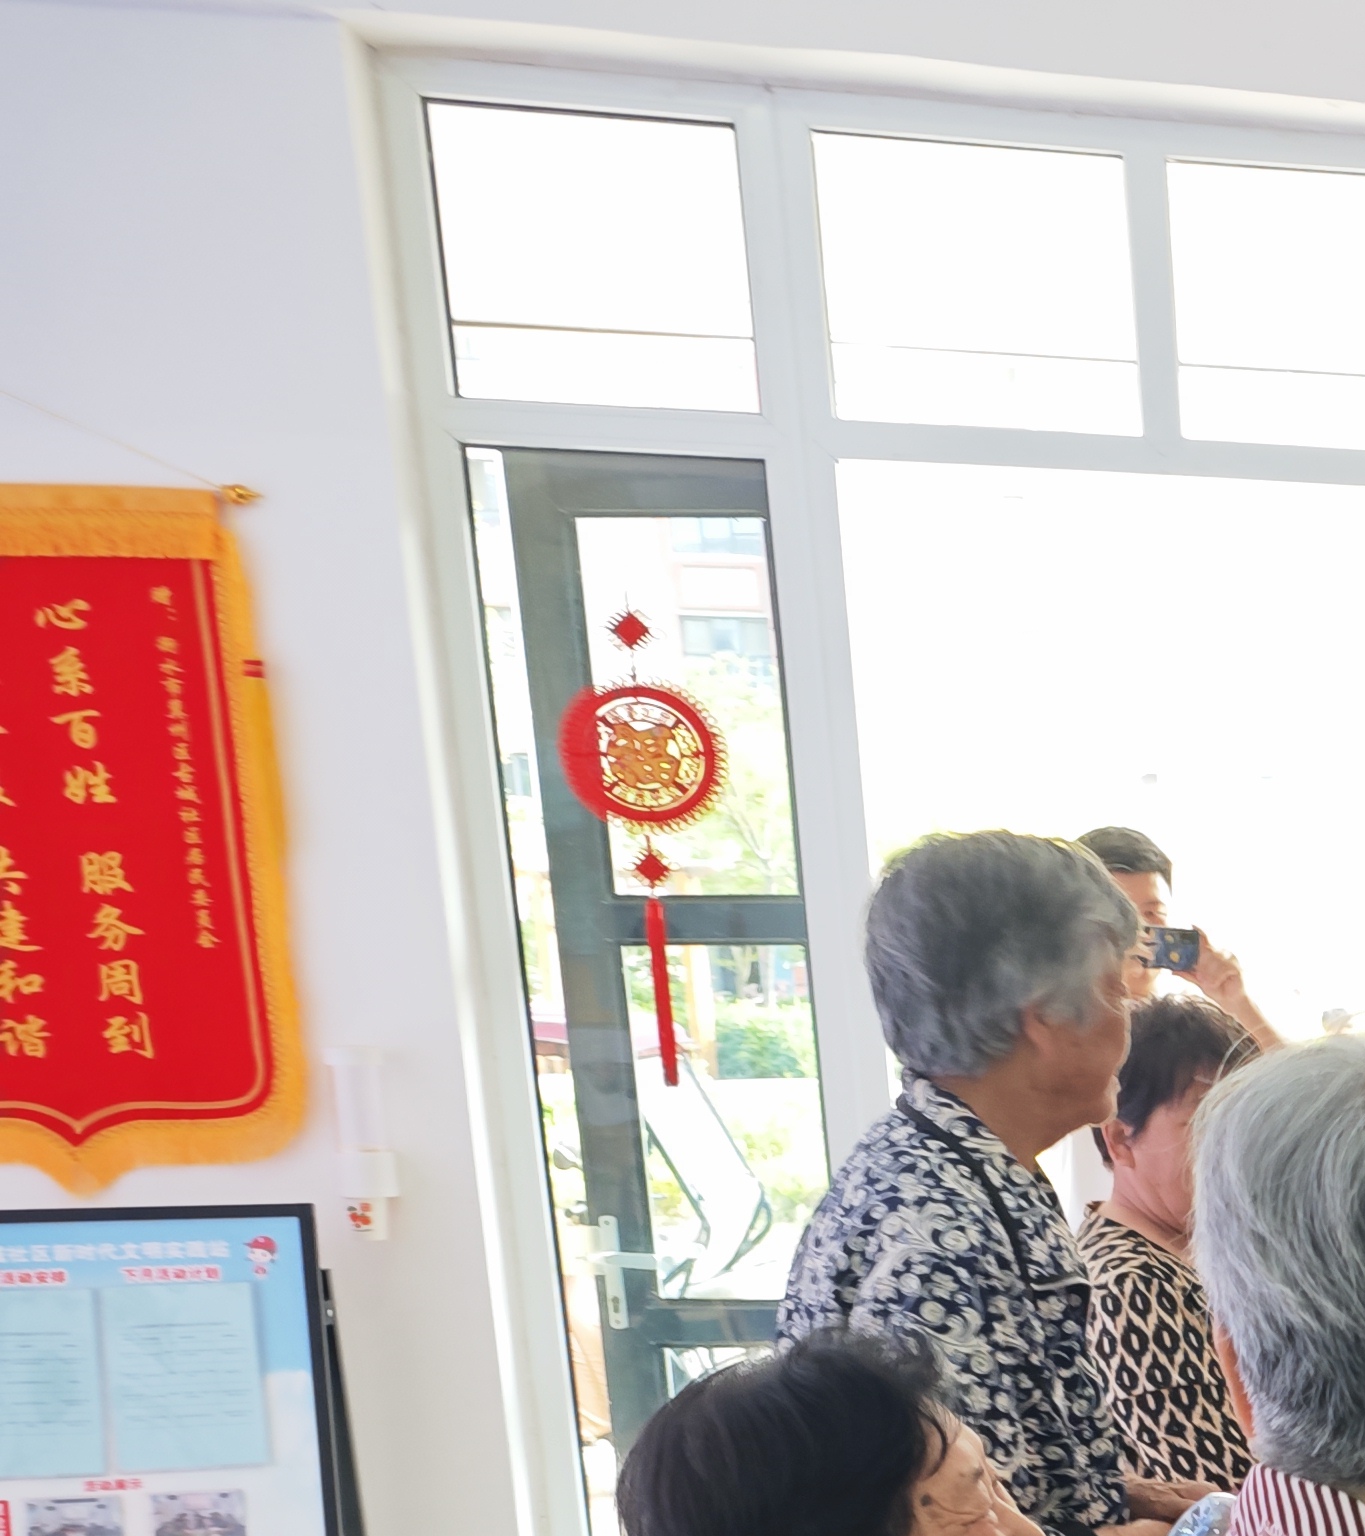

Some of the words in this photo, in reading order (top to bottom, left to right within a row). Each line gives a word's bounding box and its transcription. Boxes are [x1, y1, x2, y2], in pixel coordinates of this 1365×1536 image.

[34, 597, 118, 805] 心系百姓
[80, 850, 156, 1060] 服务周到
